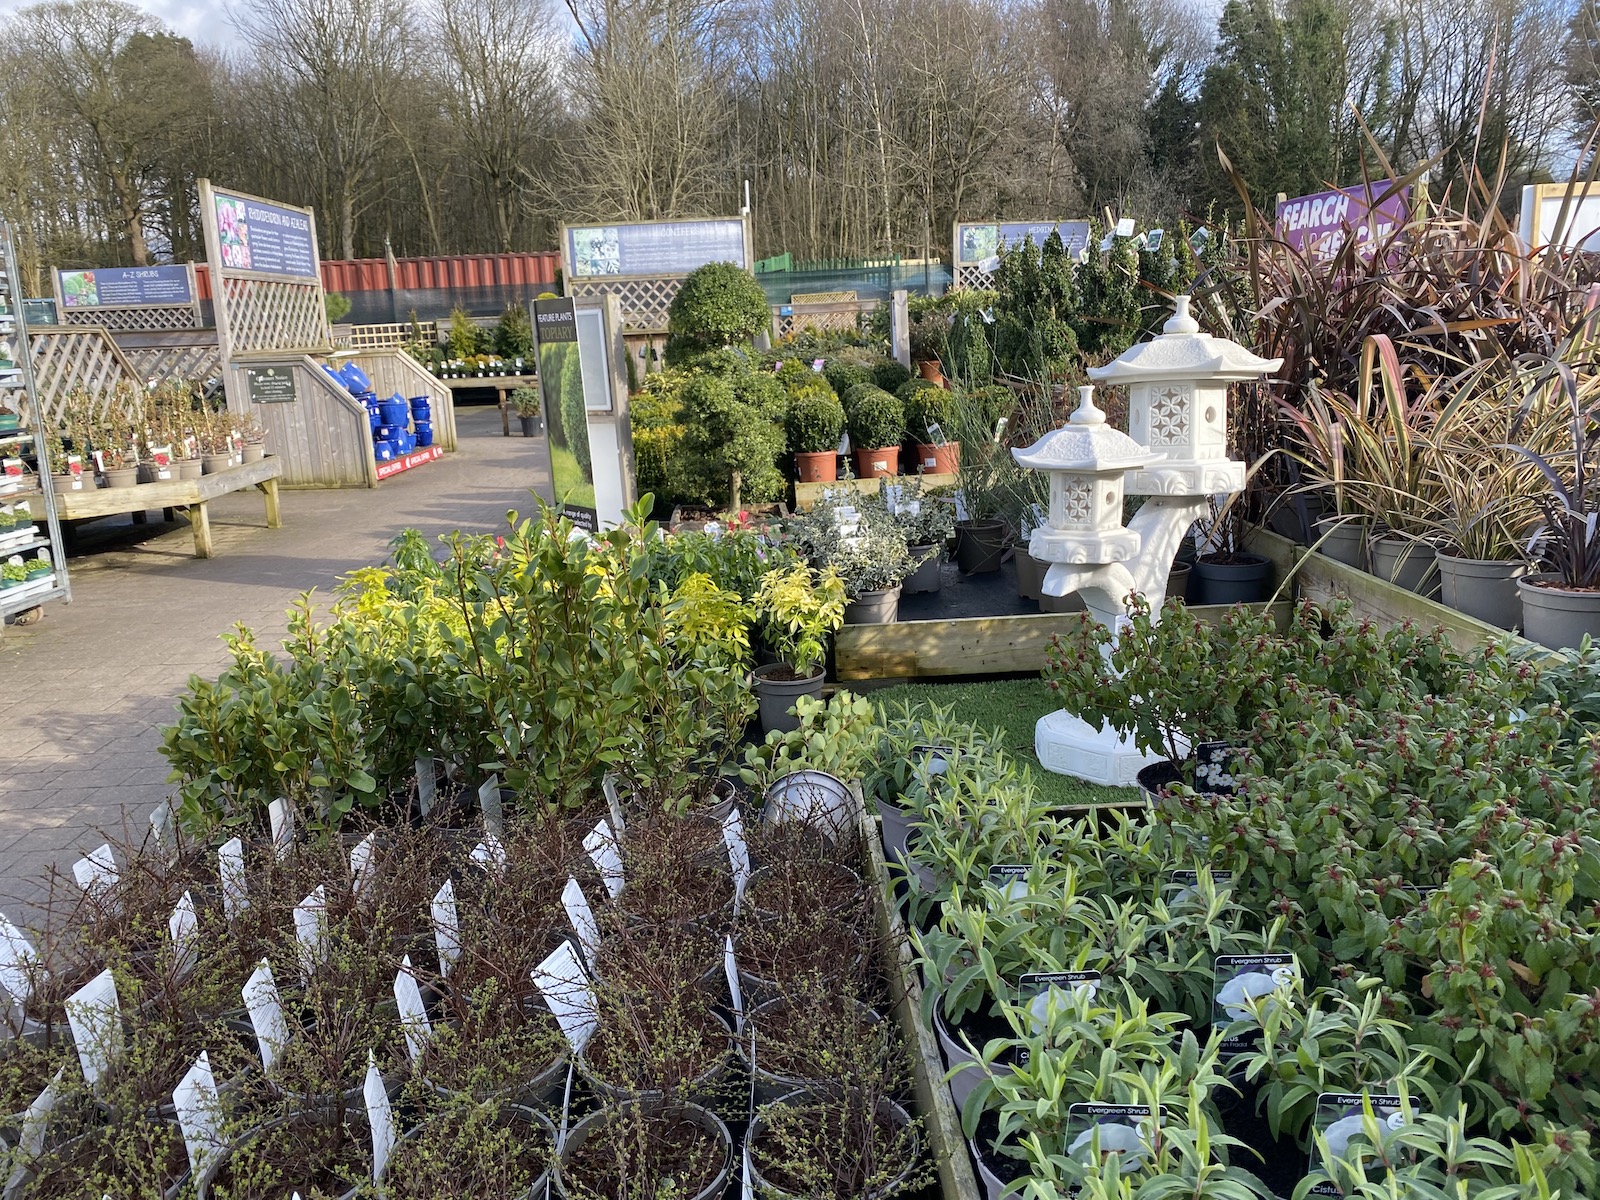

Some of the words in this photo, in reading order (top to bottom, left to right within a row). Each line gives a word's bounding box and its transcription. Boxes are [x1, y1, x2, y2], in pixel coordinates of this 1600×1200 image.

[1283, 194, 1350, 232] SEARCH
[660, 227, 700, 238] CONIFERS
[1028, 226, 1055, 234] HEDGIN
[1298, 233, 1318, 251] AD
[1318, 223, 1391, 261] RECUE
[122, 271, 135, 279] A-Z
[136, 270, 159, 278] SHRUBS
[537, 312, 555, 322] FEATURE
[555, 312, 572, 322] PLANTS
[541, 326, 573, 340] TOPIARY
[1337, 1096, 1378, 1105] Evergrn
[1378, 1098, 1401, 1106] Shrub
[1088, 1106, 1126, 1114] Evergreen
